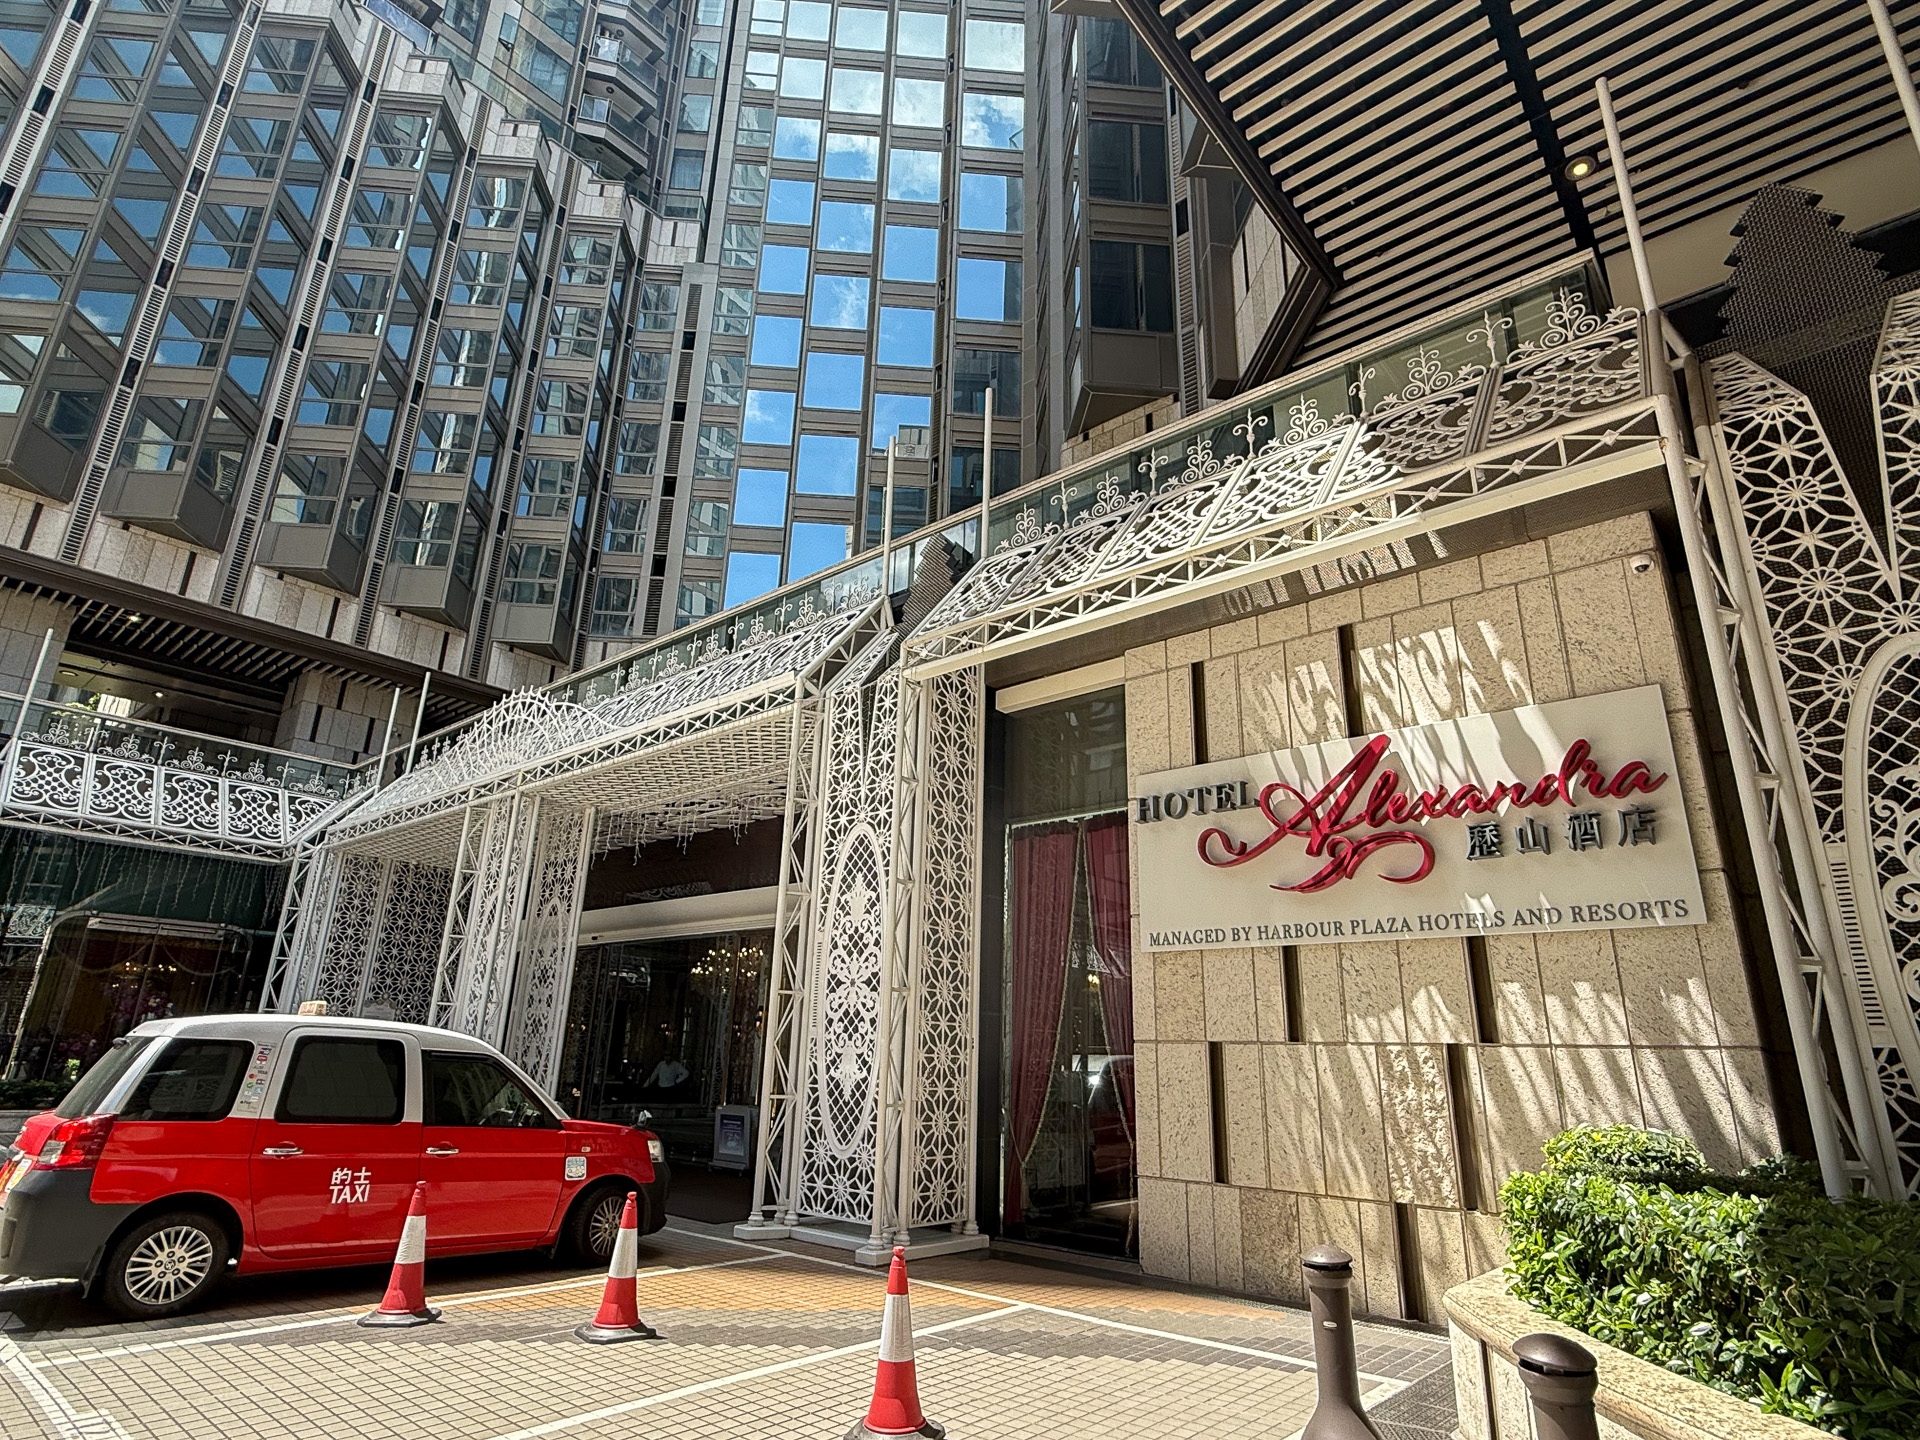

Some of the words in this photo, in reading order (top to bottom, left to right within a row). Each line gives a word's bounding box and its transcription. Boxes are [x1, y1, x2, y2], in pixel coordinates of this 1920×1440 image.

[1135, 780, 1261, 824] HOTEL
[1198, 734, 1668, 893] Alexandra
[1466, 803, 1656, 861] 歷山酒店
[1149, 928, 1226, 947] MANAGED
[1231, 926, 1252, 942] BY
[1257, 920, 1345, 941] HARBOUR
[1350, 915, 1412, 935] PLAZA
[1418, 910, 1506, 933] HOTELS
[1512, 907, 1562, 927] AND
[1569, 899, 1689, 924] RESORTS
[329, 1184, 370, 1204] TAXI
[331, 1166, 371, 1185] 的士
